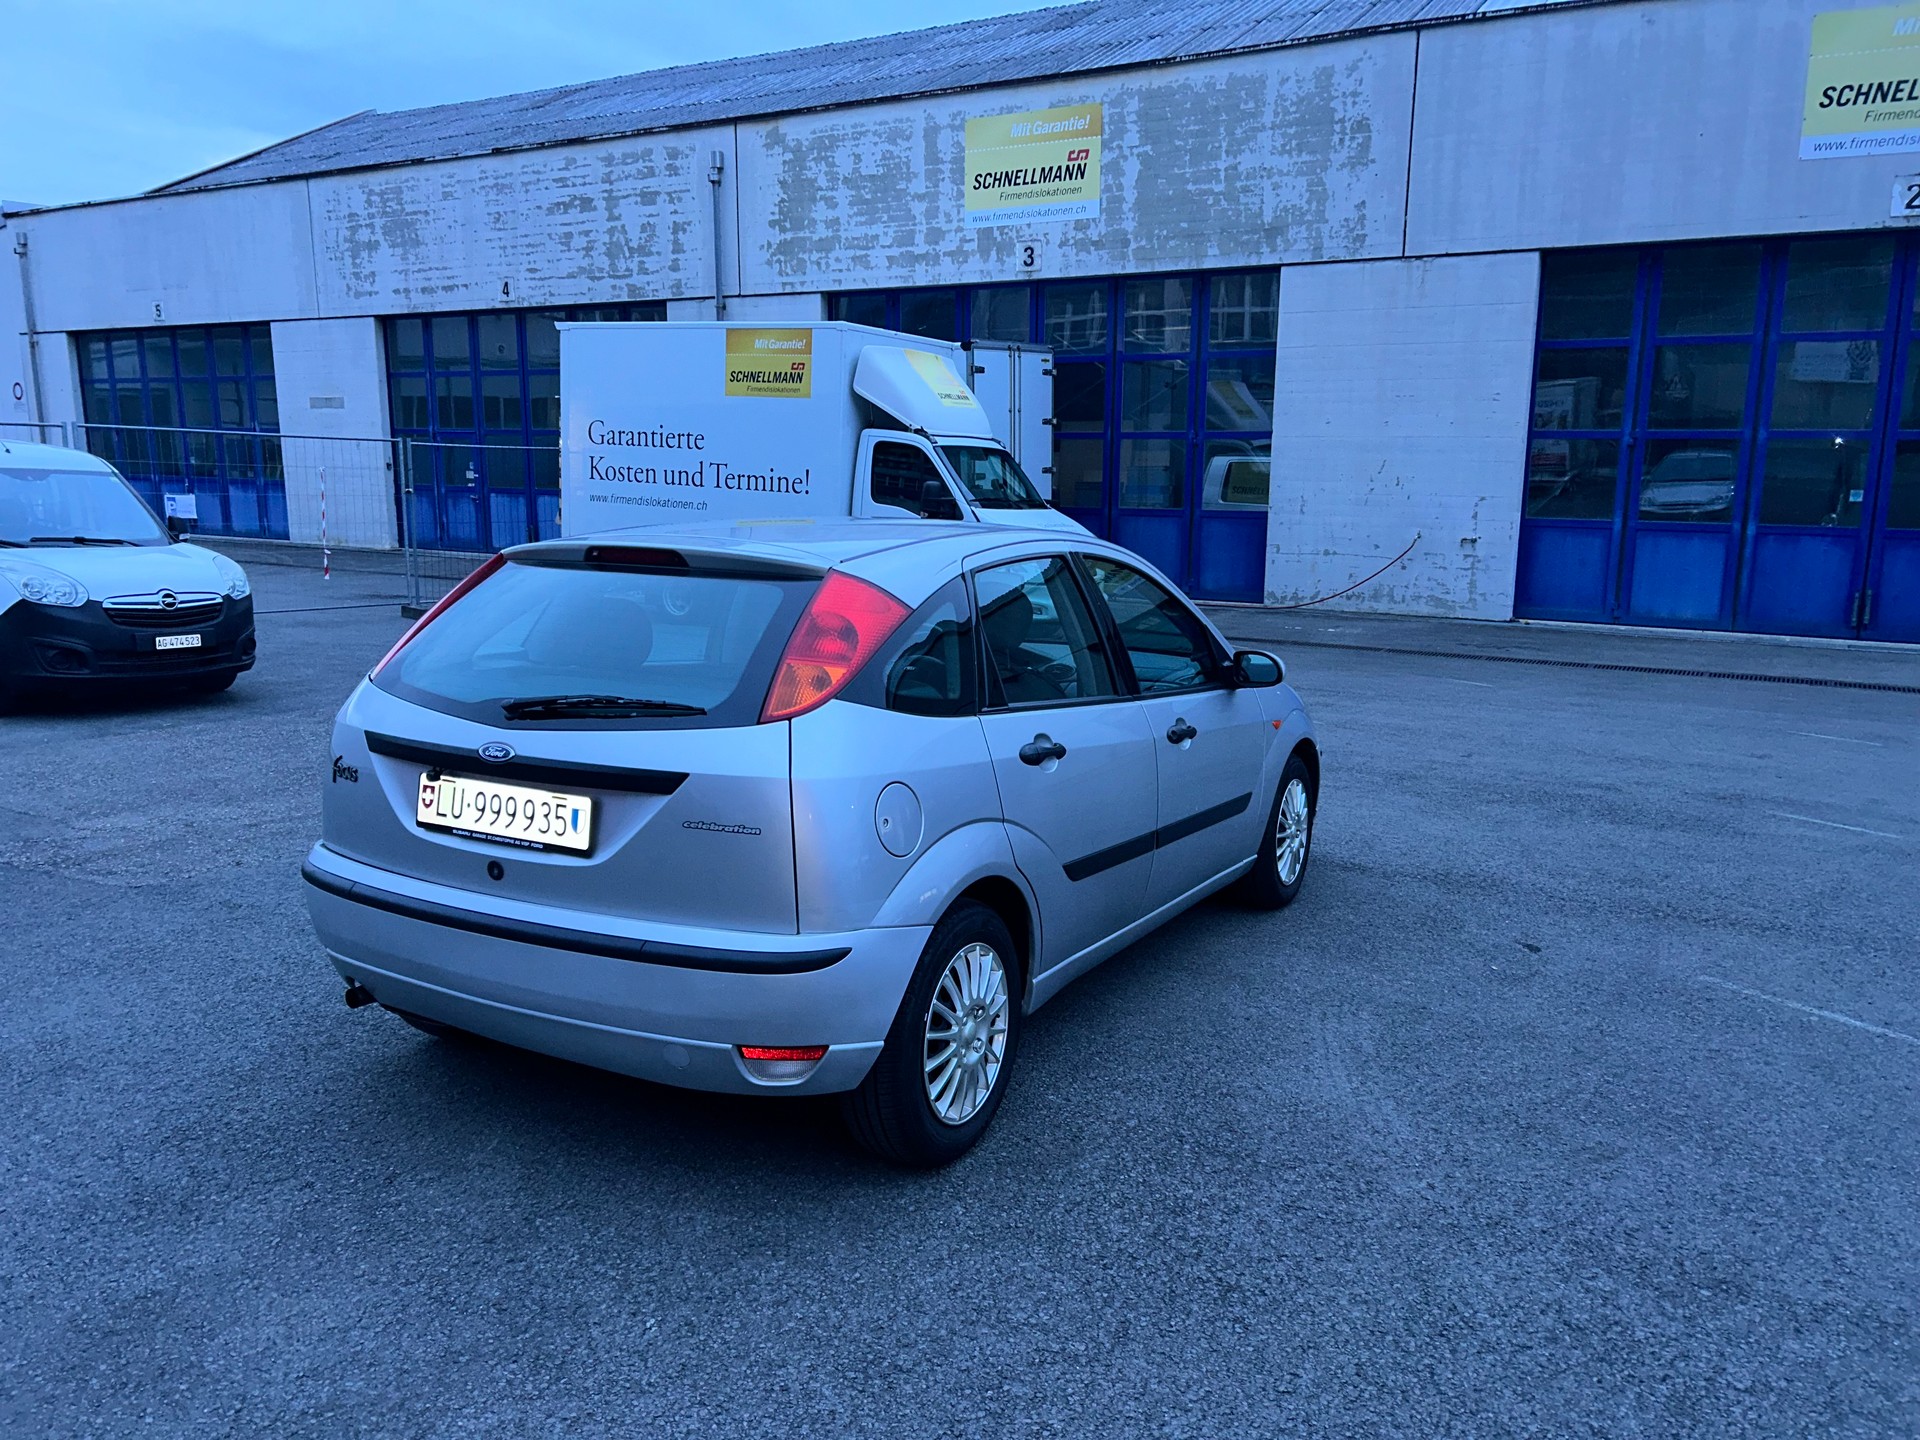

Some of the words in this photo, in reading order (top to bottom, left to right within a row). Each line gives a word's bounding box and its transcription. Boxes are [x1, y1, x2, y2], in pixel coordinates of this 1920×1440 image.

[1818, 79, 1919, 109] SCHNEL
[1010, 123, 1031, 138] Mit
[1032, 115, 1091, 135] Garantie!
[972, 162, 1087, 190] SCHNELLMANN
[999, 185, 1082, 201] Firmendislokationen
[1904, 183, 1920, 210] 2
[972, 205, 1087, 223] www.firmendislokationen.ch
[1023, 246, 1035, 267] 3
[502, 281, 510, 298] 4
[155, 304, 162, 318] 5
[754, 339, 768, 349] Mit
[768, 339, 806, 349] Garantie!
[729, 370, 804, 384] SCHNELLMANN
[746, 385, 800, 393] Firmendislokationen
[588, 419, 705, 450] Garantierte
[589, 455, 657, 484] Kosten
[663, 461, 705, 487] und
[709, 461, 811, 495] Termine!
[1232, 486, 1268, 496] SCHNELL
[589, 493, 708, 511] www.firmendislokationen.ch
[485, 746, 507, 757] Ford
[682, 821, 761, 836] celebration
